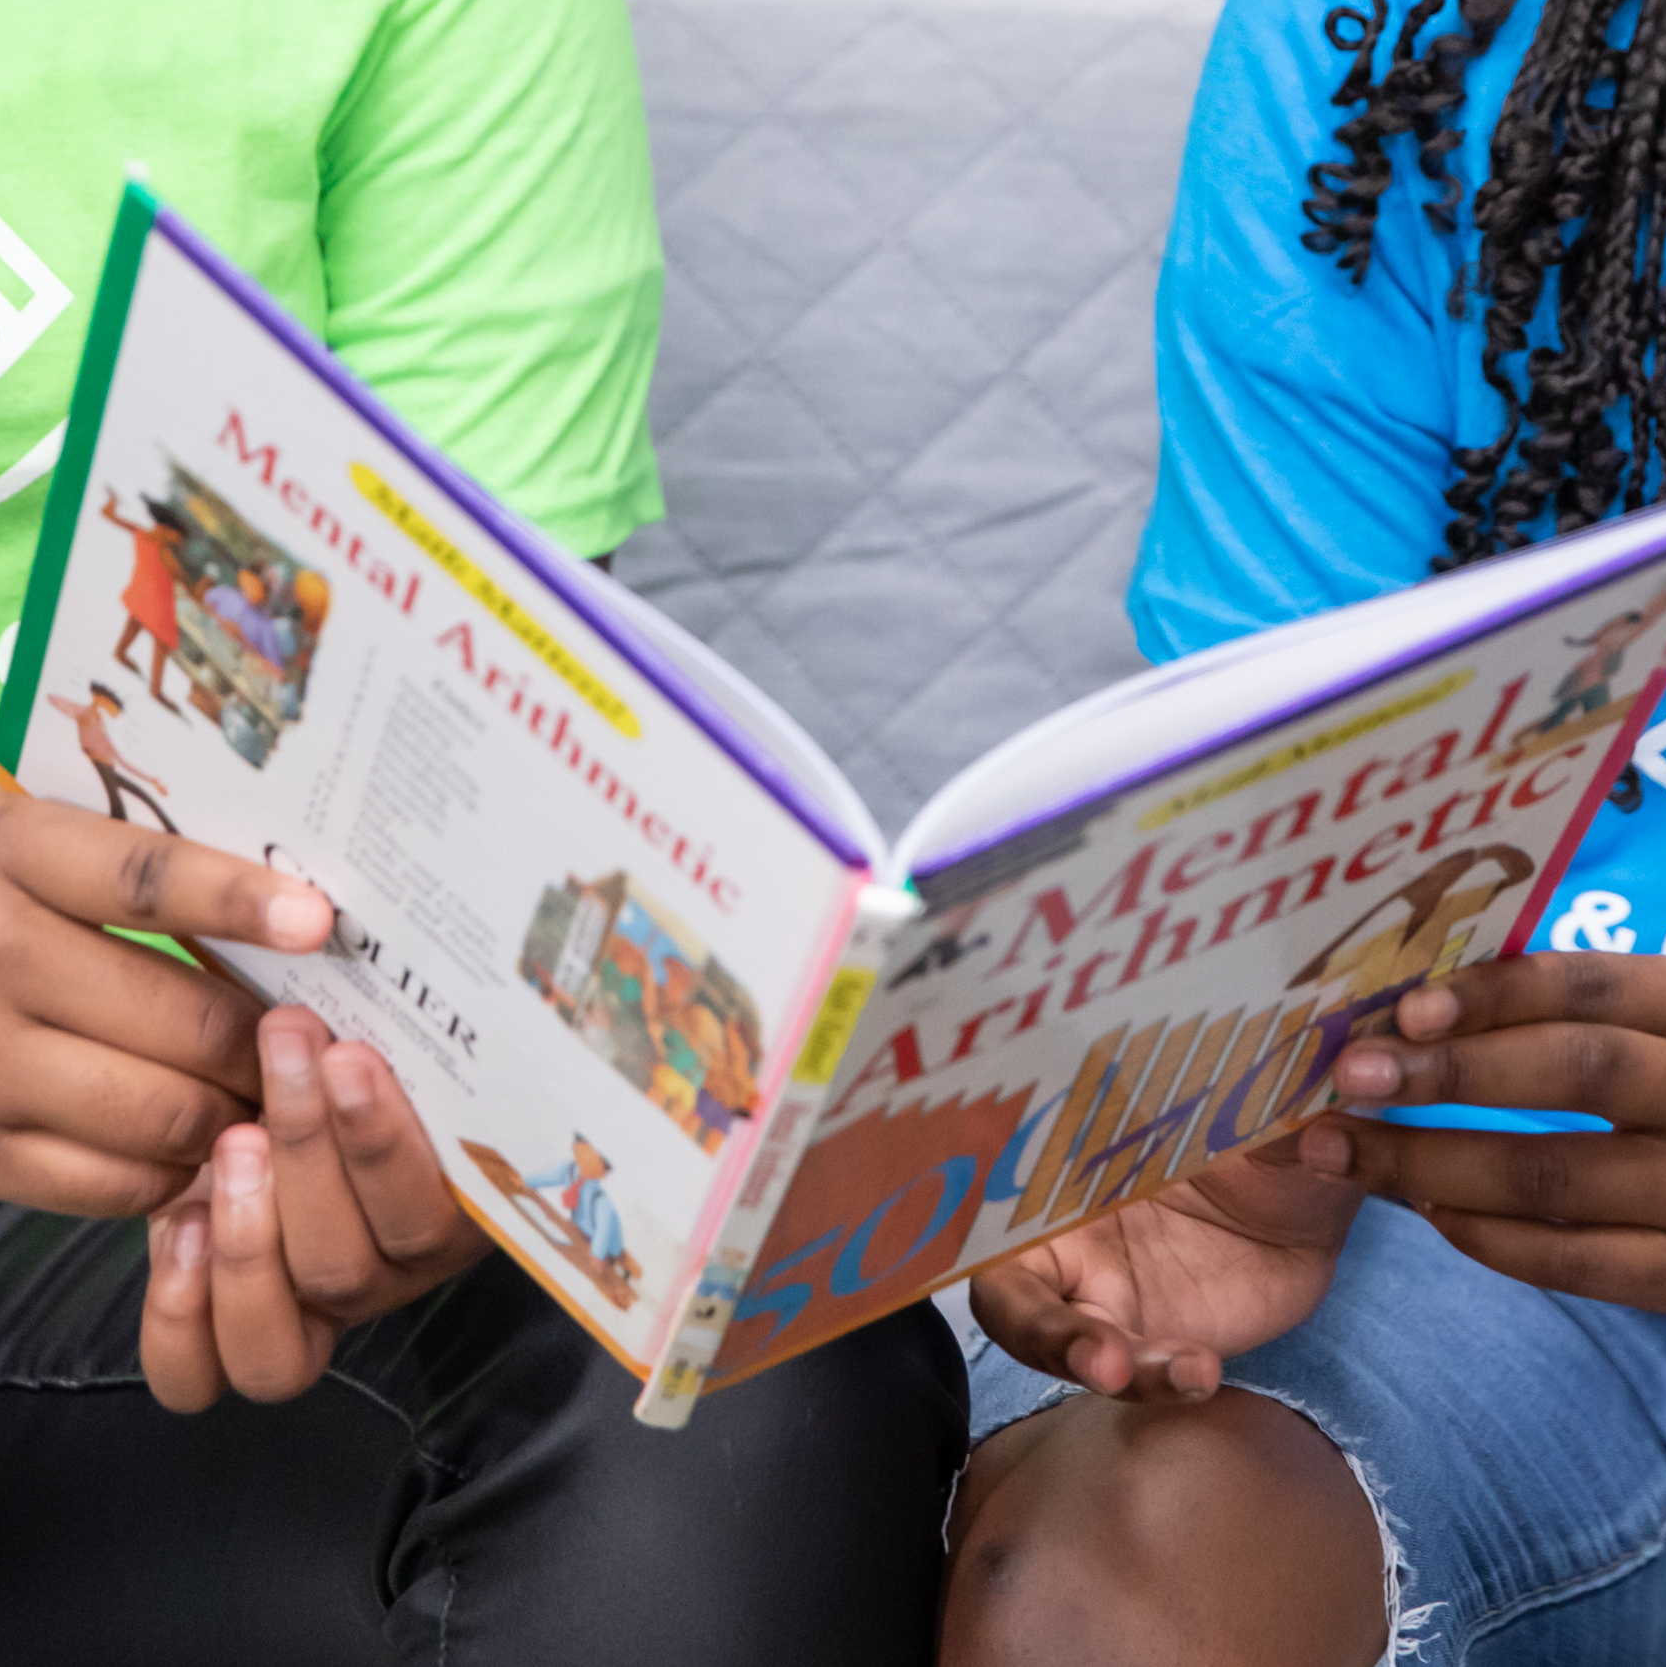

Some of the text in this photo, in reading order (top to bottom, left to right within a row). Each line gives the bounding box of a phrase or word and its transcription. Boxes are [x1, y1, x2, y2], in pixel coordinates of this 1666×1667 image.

[218, 408, 421, 615] Mental
[435, 620, 743, 916] Arithmetic
[264, 841, 480, 1061] GOLIER
[830, 742, 1585, 1120] Arithmetic
[985, 672, 1533, 982] Mental
[1550, 890, 1637, 955] &
